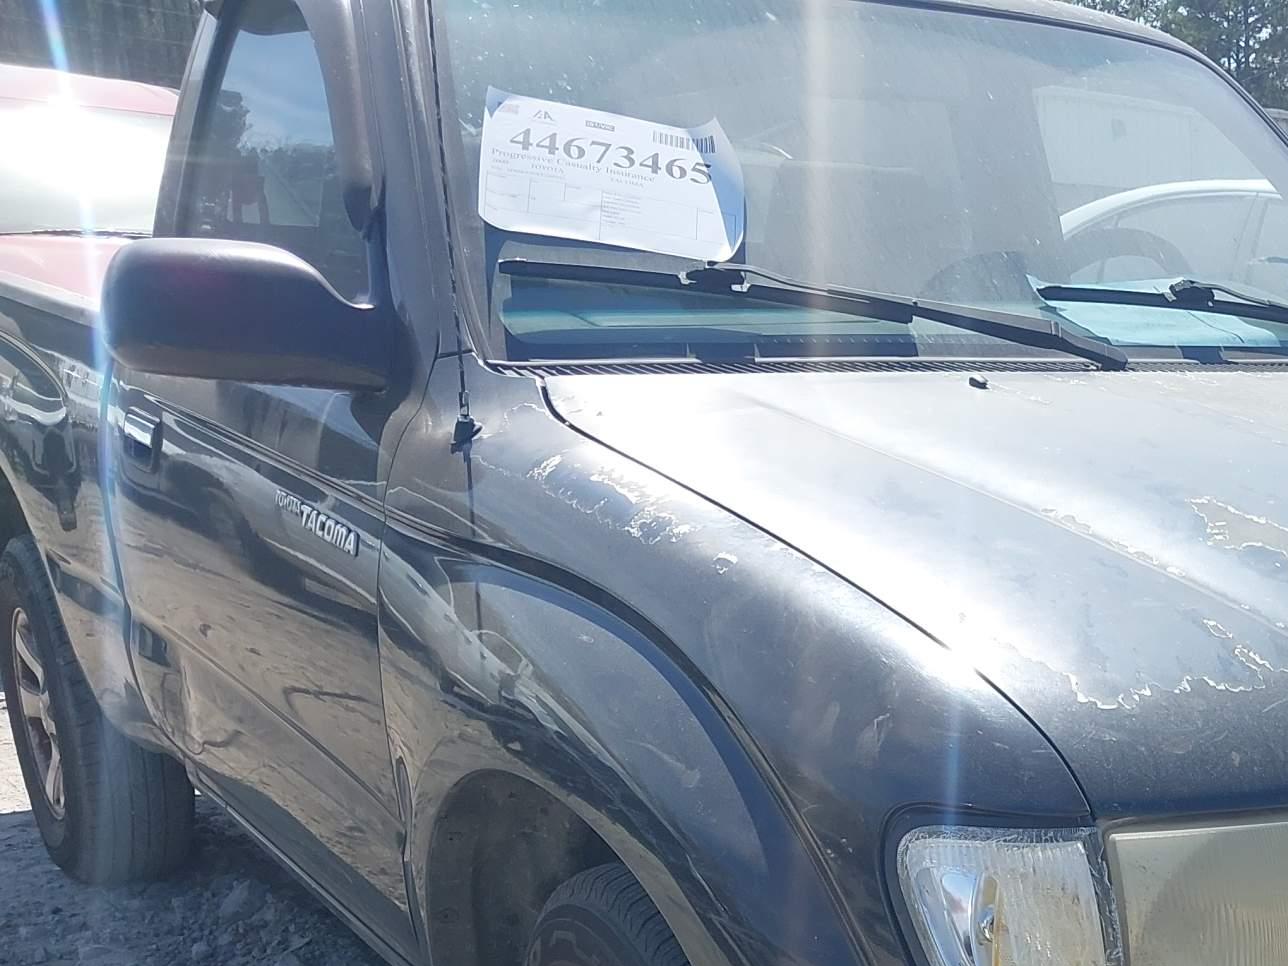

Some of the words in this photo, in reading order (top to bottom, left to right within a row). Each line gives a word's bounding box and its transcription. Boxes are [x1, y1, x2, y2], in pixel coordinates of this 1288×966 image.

[492, 147, 555, 164] Progressive
[557, 158, 602, 174] Casualty
[606, 167, 656, 182] Insurance
[508, 127, 713, 185] 44673465
[274, 489, 302, 515] TOYOTA
[300, 504, 359, 556] TACOMA
